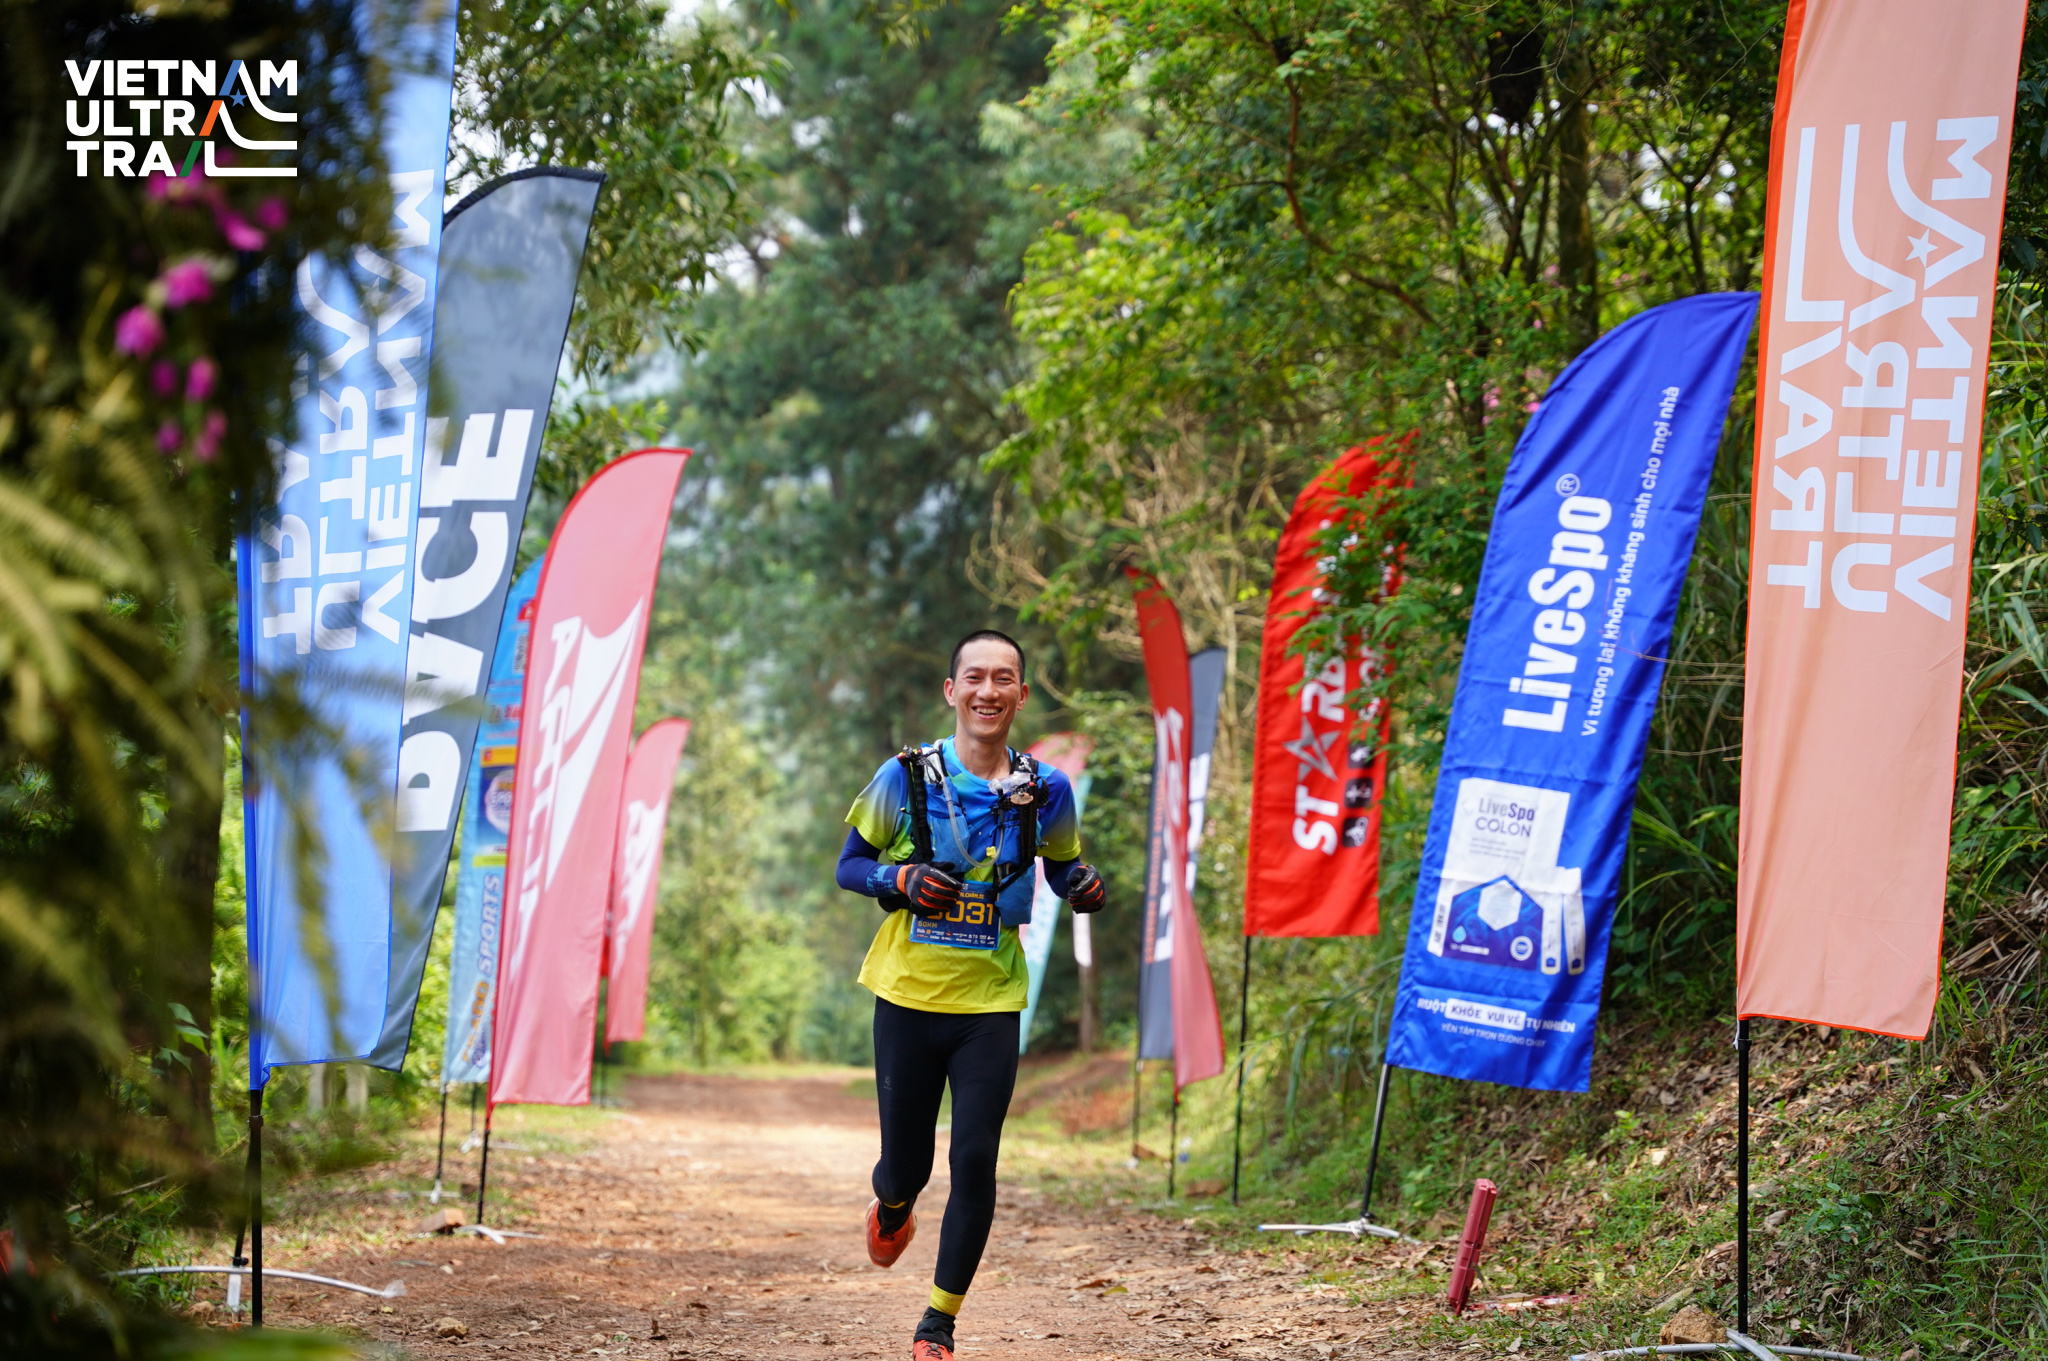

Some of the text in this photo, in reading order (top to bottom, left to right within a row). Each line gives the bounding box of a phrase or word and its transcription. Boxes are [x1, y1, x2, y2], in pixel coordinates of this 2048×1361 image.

[1659, 386, 1680, 419] nhà
[1651, 421, 1673, 455] mọi
[1641, 457, 1661, 490] cho
[1630, 492, 1652, 529] sinh
[1615, 531, 1646, 584] kháng
[1603, 587, 1631, 640] không
[1475, 817, 1532, 838] COLON
[476, 872, 502, 978] SPORTS
[1487, 1011, 1505, 1023] VUI
[1542, 1018, 1576, 1034] NHIÊN
